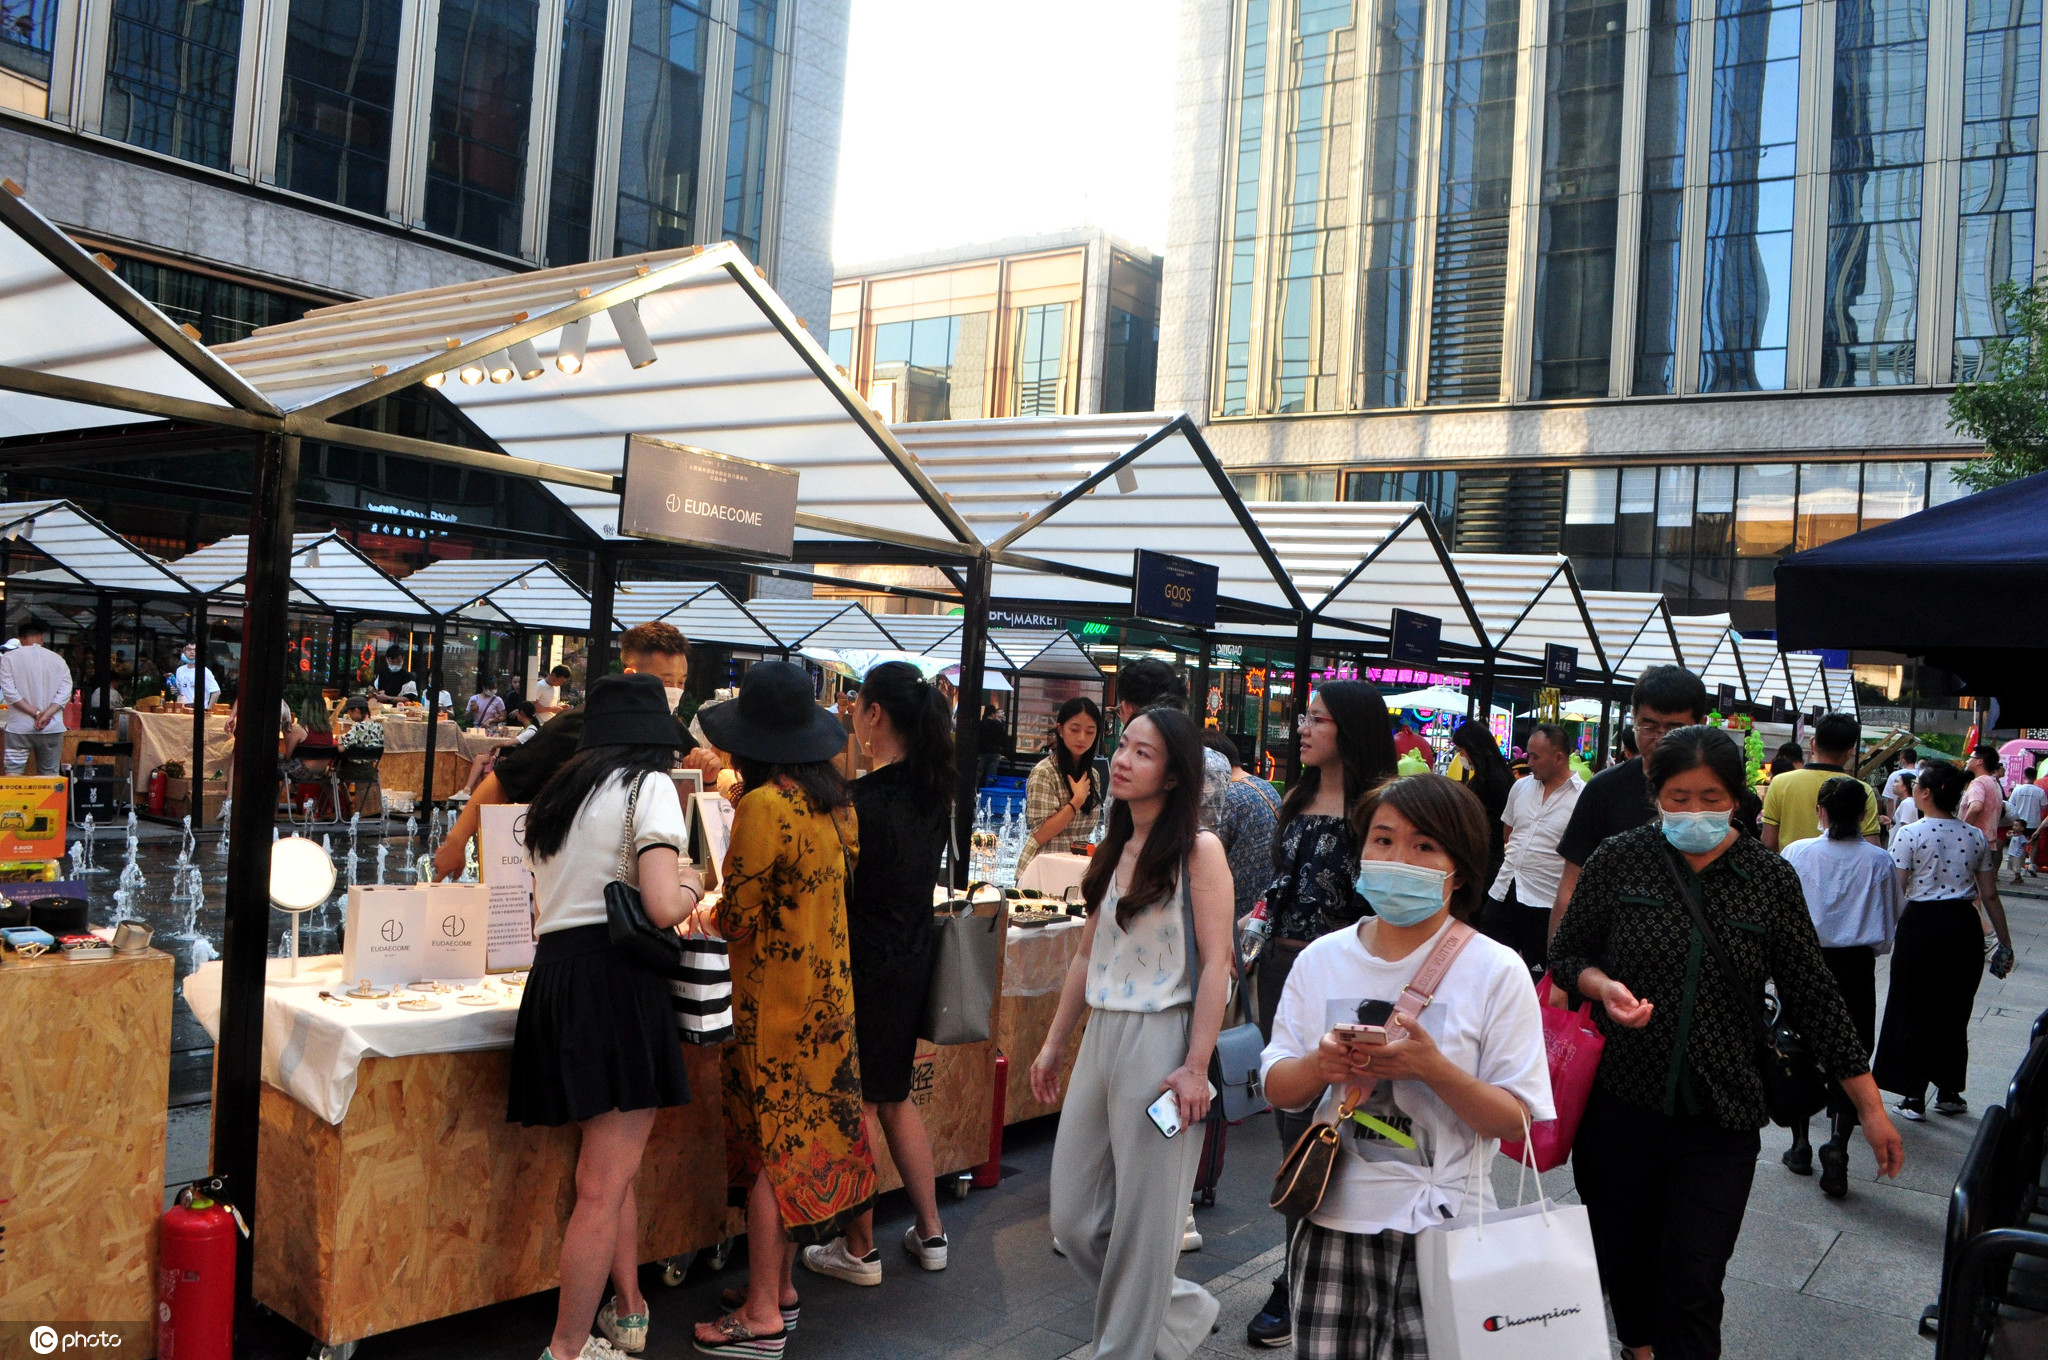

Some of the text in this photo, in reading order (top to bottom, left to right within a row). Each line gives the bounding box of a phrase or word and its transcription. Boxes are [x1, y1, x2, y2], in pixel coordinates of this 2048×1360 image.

[685, 498, 763, 527] EUDAECOME
[1164, 583, 1192, 602] GOOS
[1013, 613, 1057, 626] MARKET
[370, 944, 411, 953] EUDAECOME
[1483, 1306, 1581, 1332] Champion
